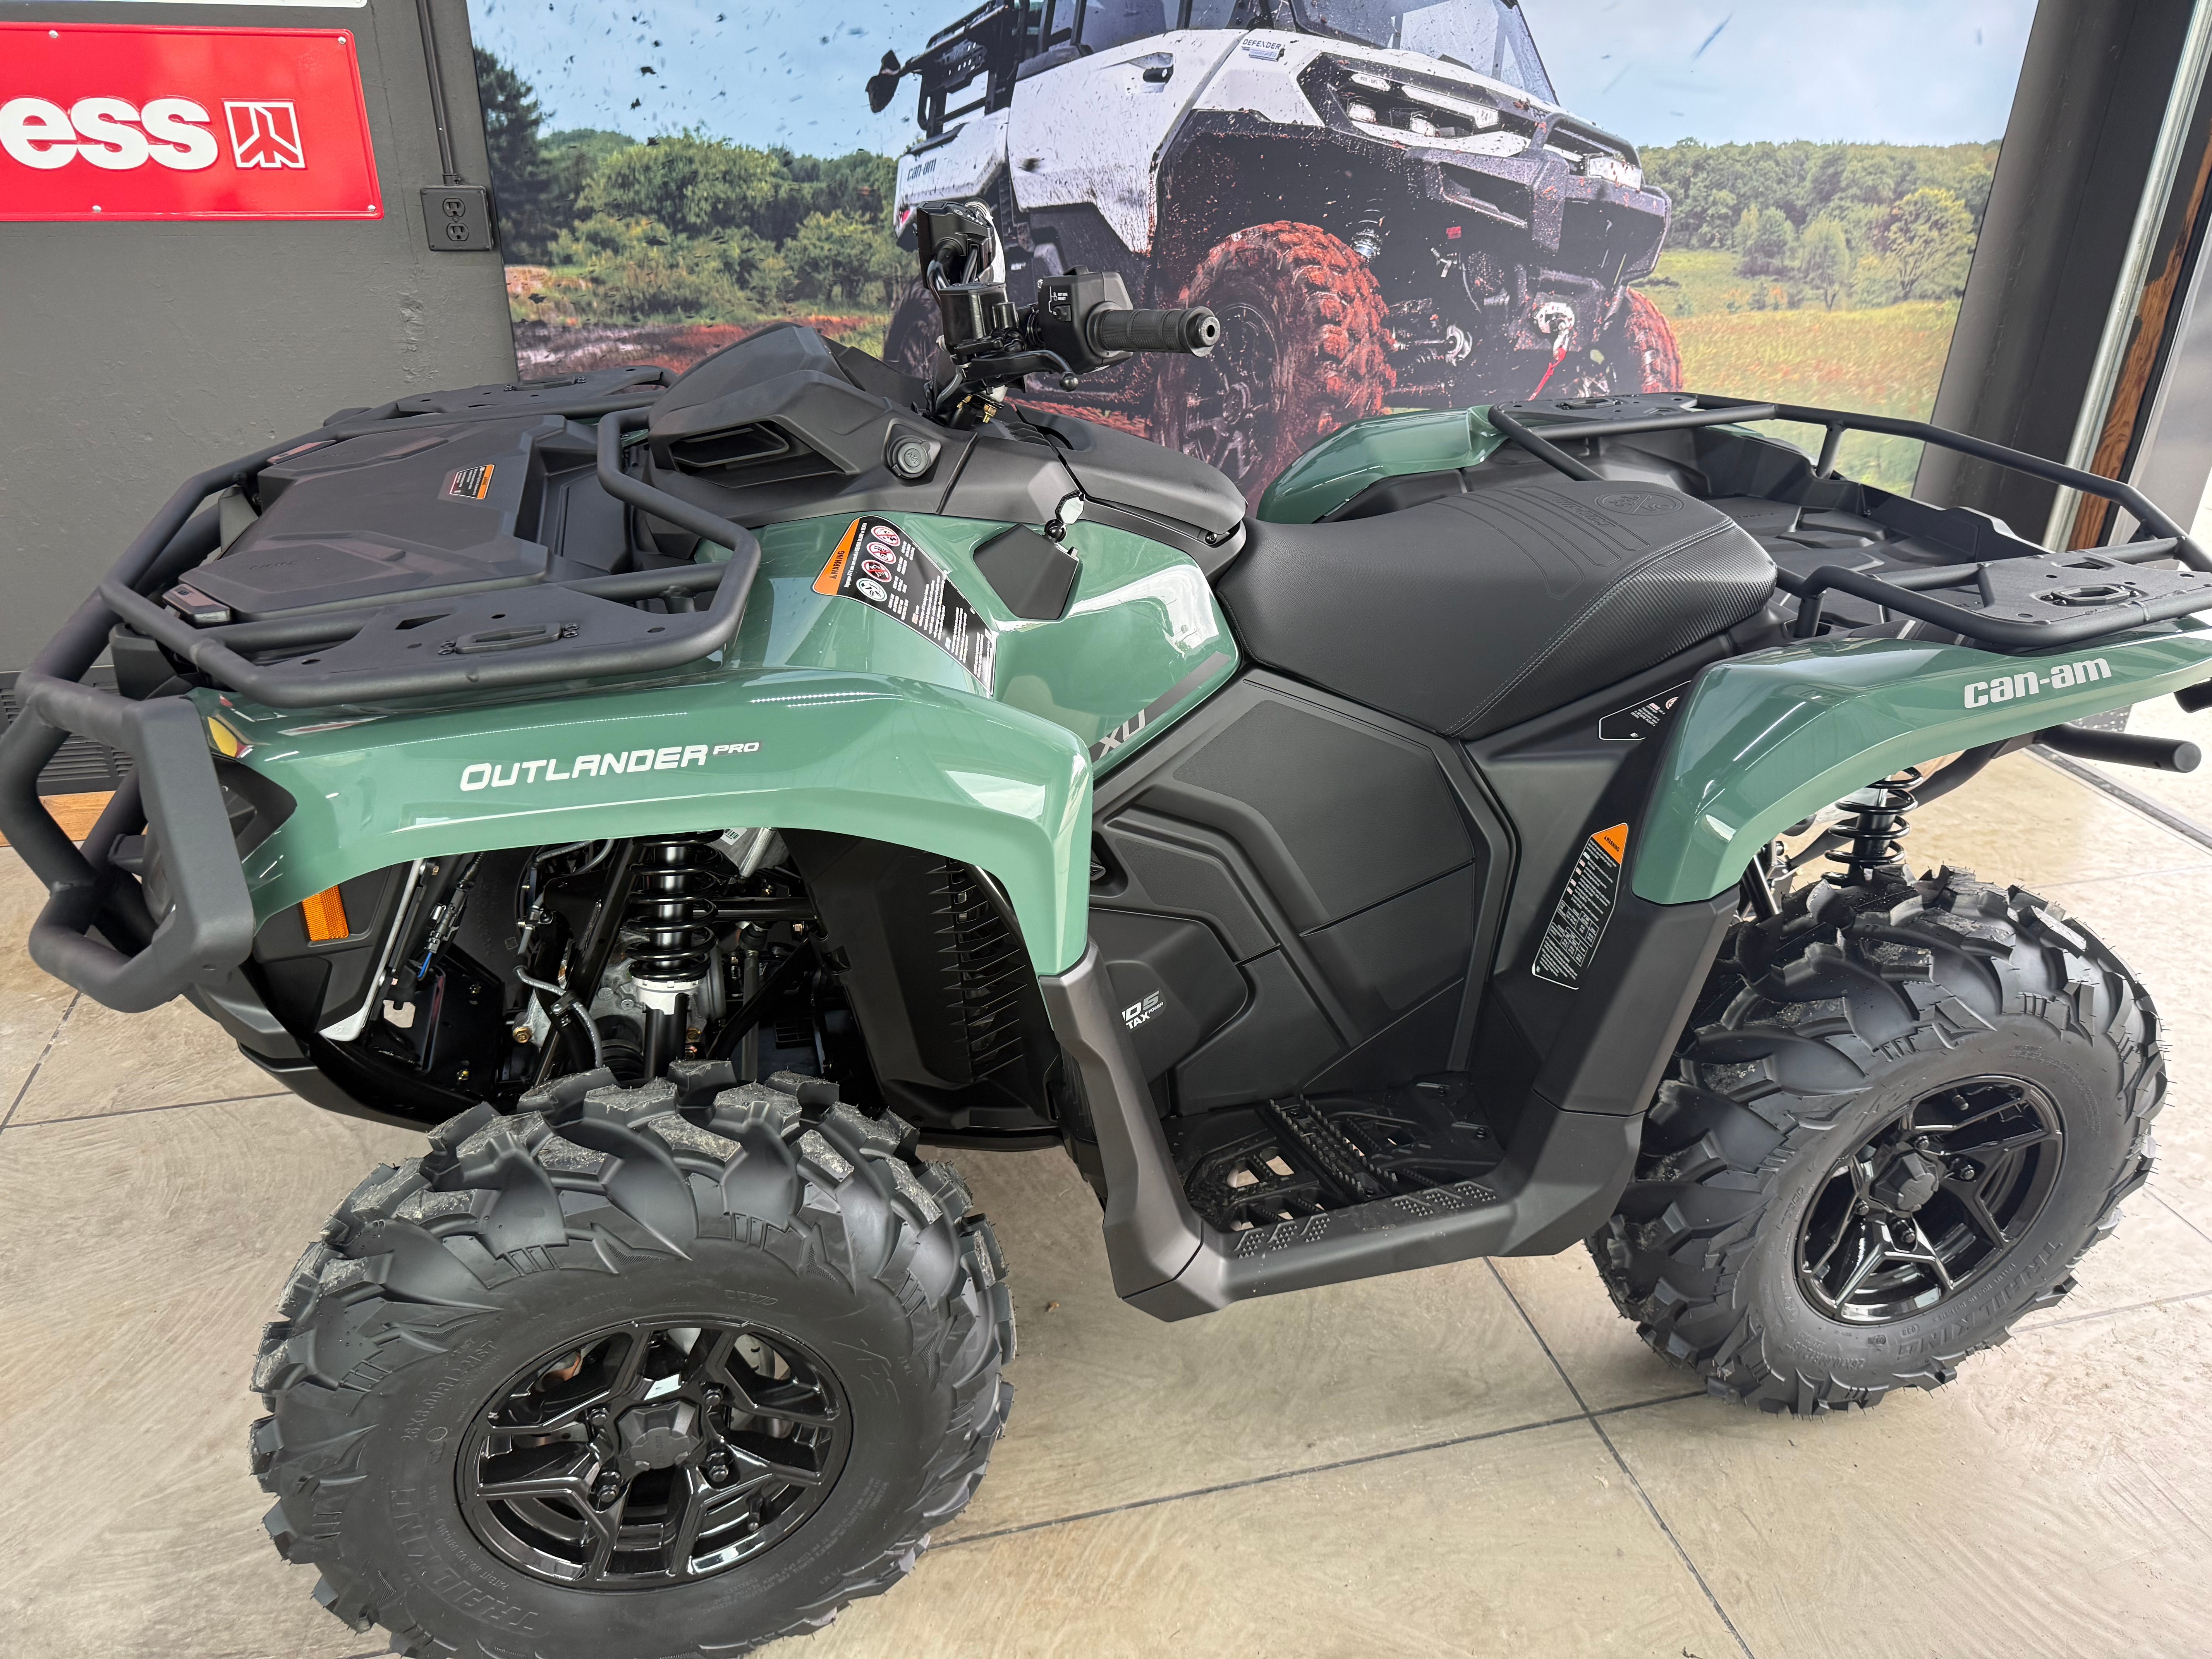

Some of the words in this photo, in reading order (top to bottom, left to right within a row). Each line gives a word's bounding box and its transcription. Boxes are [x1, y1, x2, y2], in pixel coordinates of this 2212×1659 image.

[0, 97, 218, 170] ess
[907, 157, 937, 182] can-am
[830, 550, 845, 576] WARNING
[1964, 657, 2112, 709] can-am
[460, 744, 708, 792] OUTLANDER
[713, 741, 760, 756] PRO
[1606, 836, 1620, 853] WARNING
[1148, 1002, 1164, 1014] POWER
